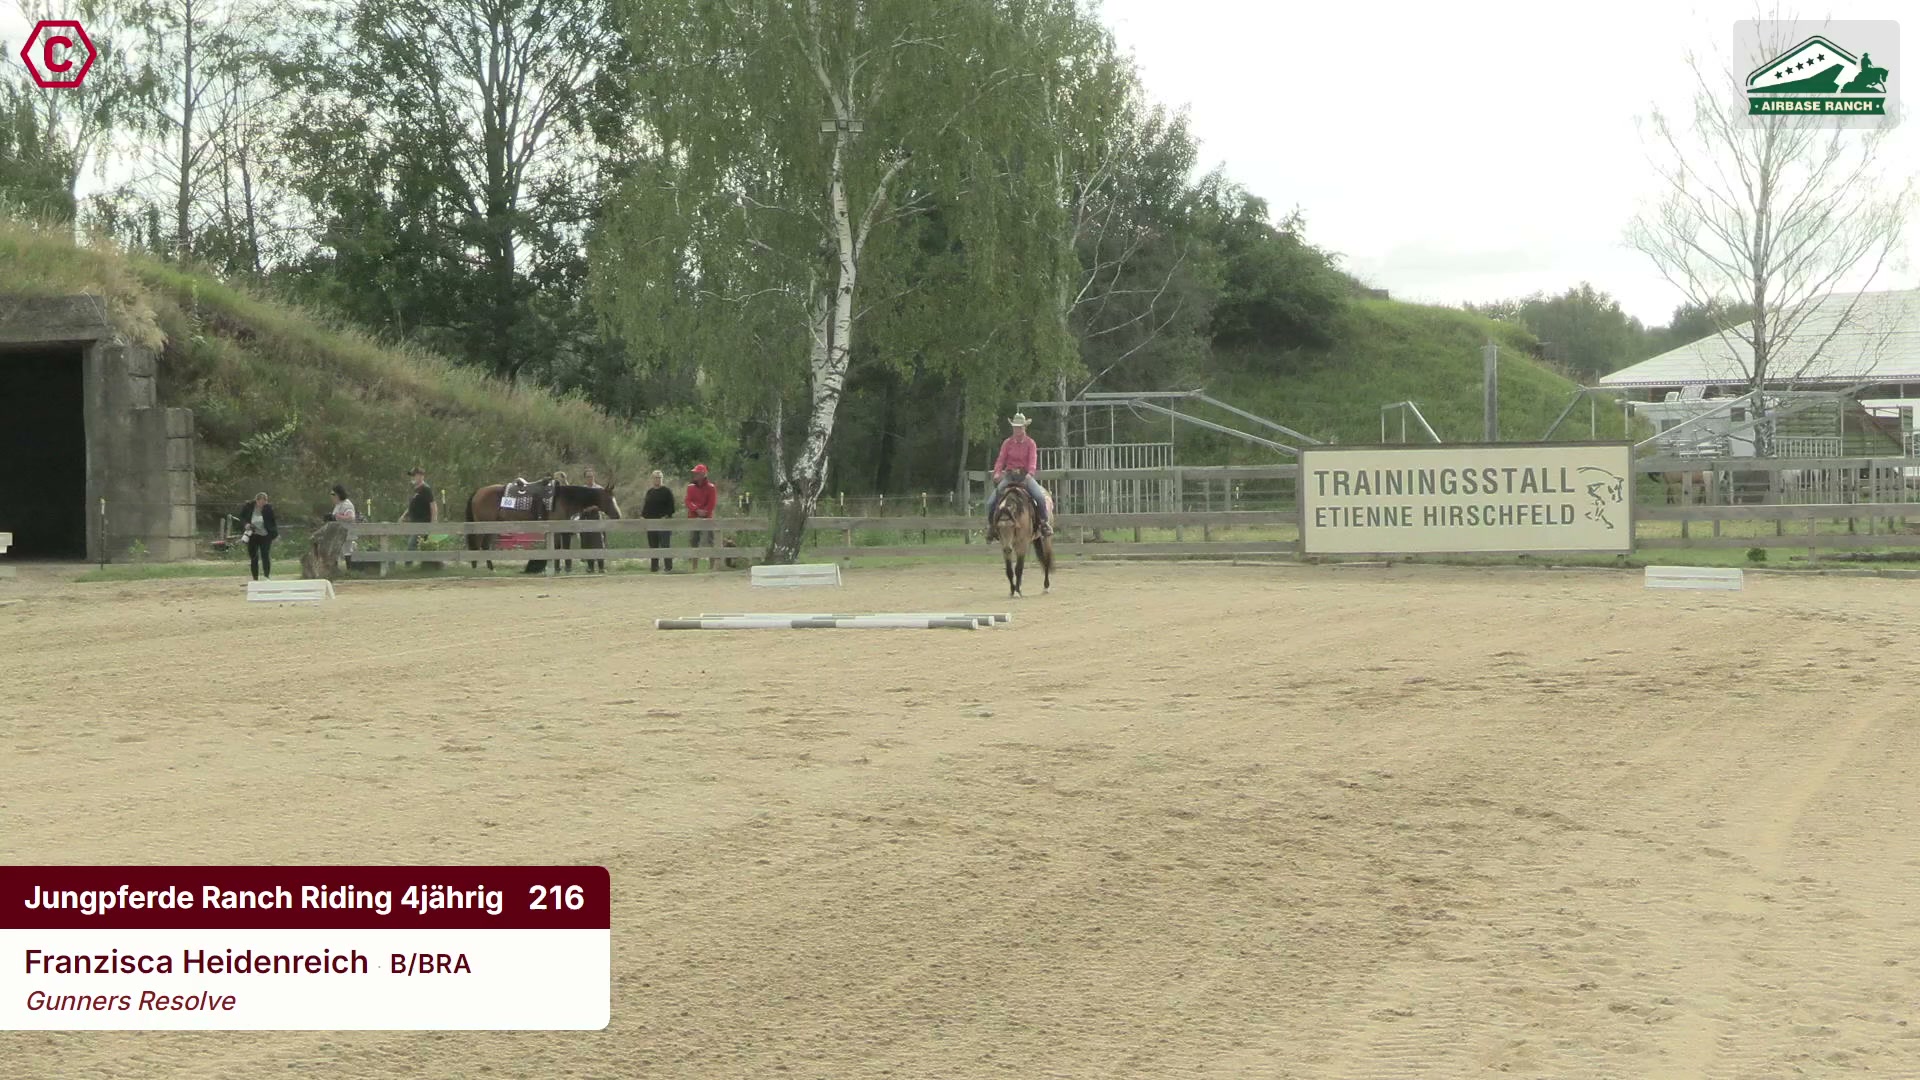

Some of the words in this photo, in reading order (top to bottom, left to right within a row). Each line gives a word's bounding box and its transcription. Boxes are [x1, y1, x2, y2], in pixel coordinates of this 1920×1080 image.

[1314, 467, 1576, 496] TRAININGSSTALL
[1315, 505, 1413, 528] ETIENNE
[1423, 504, 1576, 527] HIRSCHFELD
